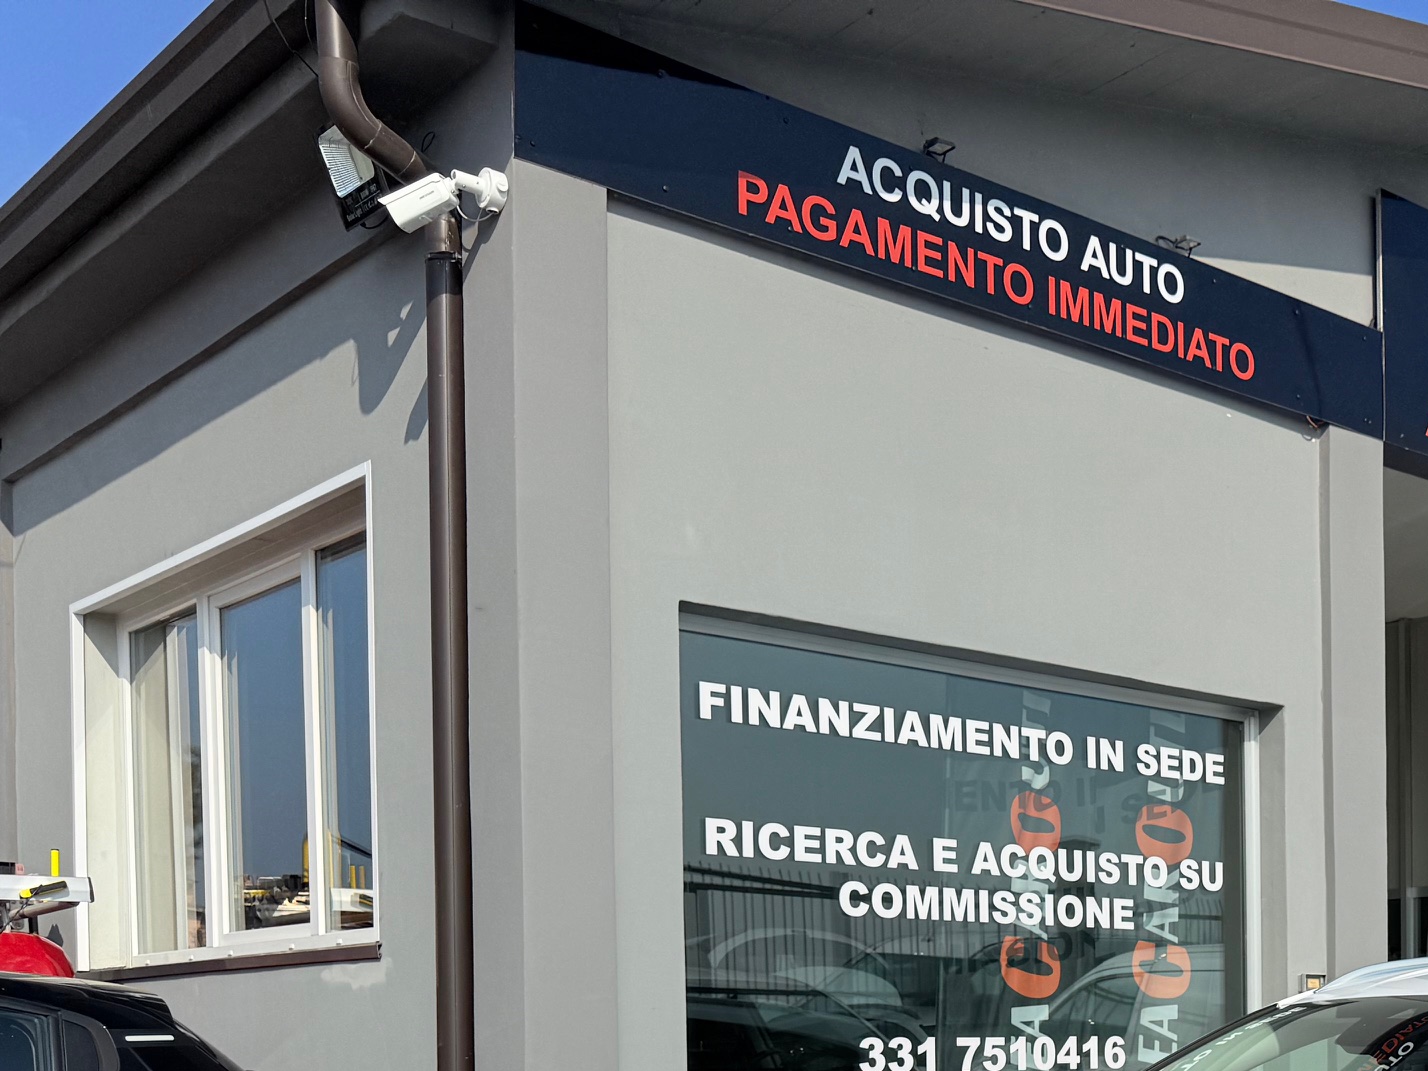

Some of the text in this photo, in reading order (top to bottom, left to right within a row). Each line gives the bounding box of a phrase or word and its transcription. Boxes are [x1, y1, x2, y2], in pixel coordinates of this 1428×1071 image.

[737, 170, 1256, 381] PAGAMENTO IMMEDIATO
[836, 145, 1185, 305] ACQUISTO AUTO
[698, 680, 1226, 785] FINANZIAMENTO IN SEDE
[704, 817, 1224, 892] RICERCA E ACQUISTO SU
[838, 881, 1135, 930] COMMISSIONE
